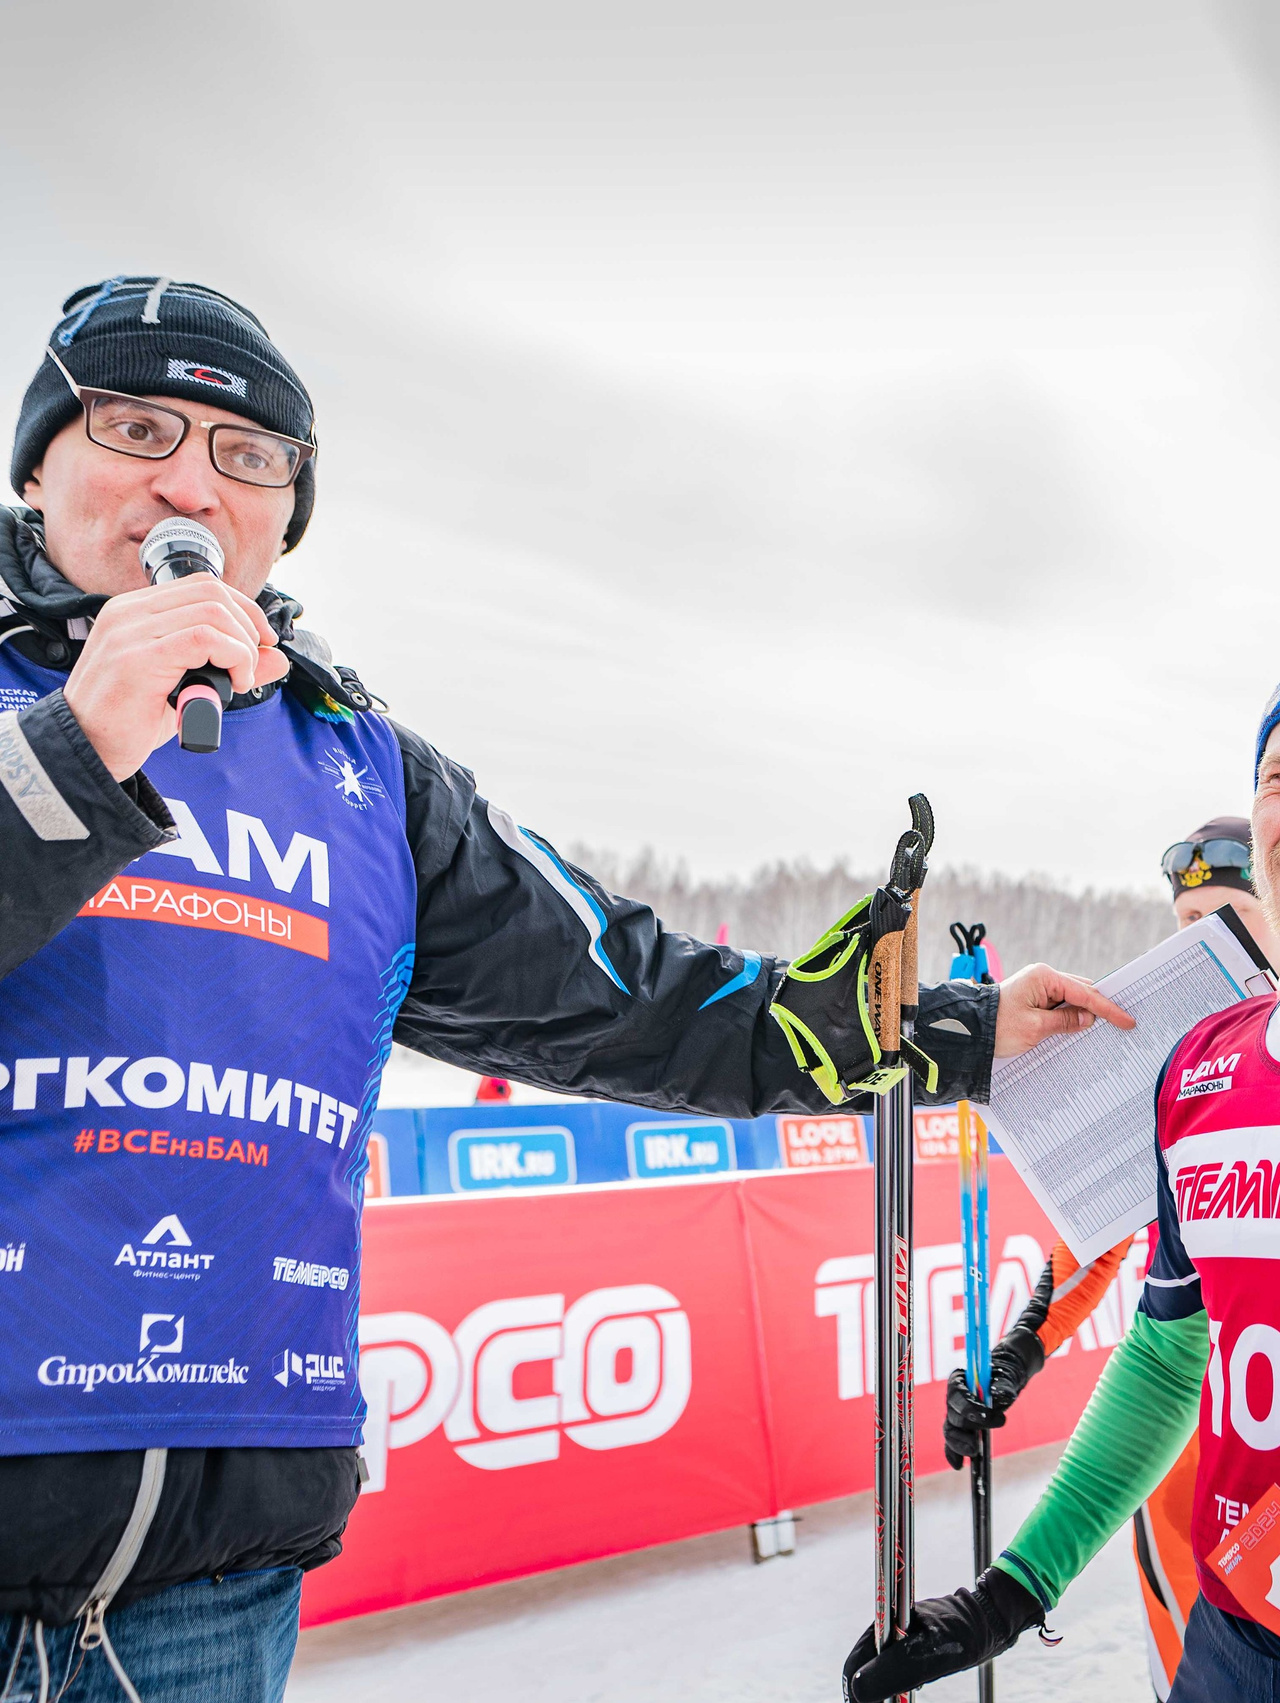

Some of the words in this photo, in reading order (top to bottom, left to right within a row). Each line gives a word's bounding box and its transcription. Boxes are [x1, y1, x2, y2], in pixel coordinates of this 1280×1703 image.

[135, 796, 330, 908] АМ
[0, 1056, 358, 1150] ГКОМИТЕТ
[1178, 1080, 1224, 1099] МАРАФОНЫ
[73, 1129, 269, 1167] #ВСЕнаБАМ
[114, 1244, 215, 1269] Атлант
[133, 1269, 201, 1281] Фитнес-центр
